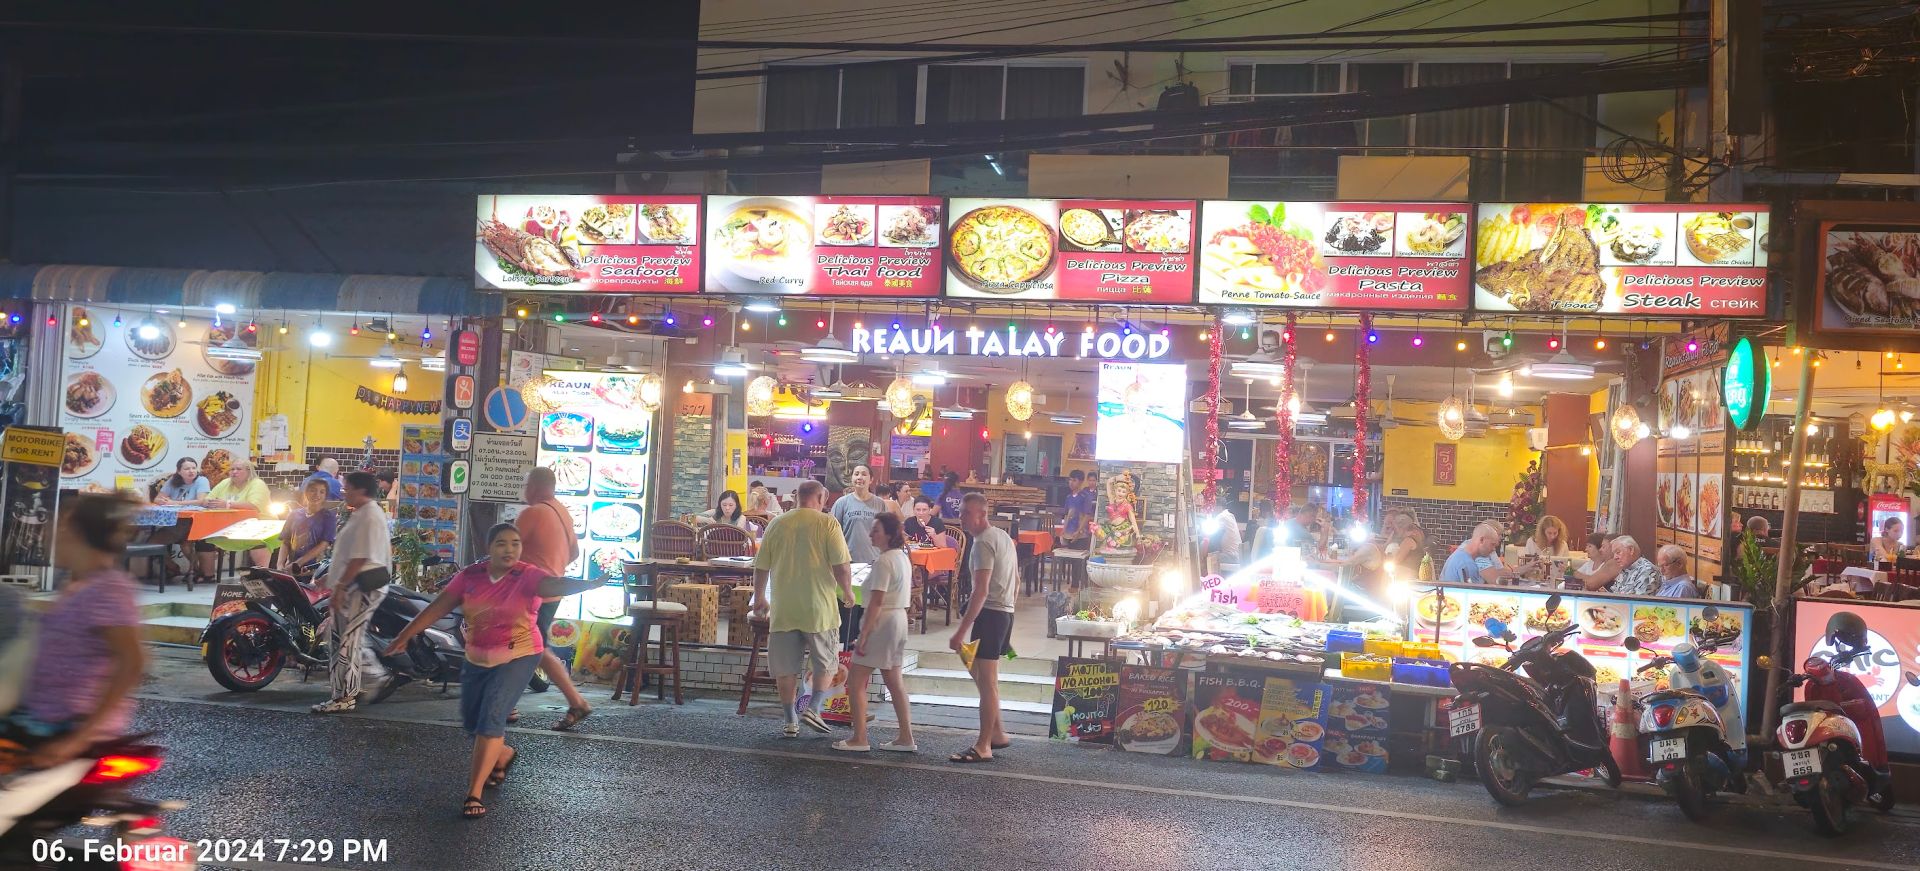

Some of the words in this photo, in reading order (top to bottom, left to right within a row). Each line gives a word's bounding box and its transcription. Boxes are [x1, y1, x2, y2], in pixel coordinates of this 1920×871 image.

[583, 255, 637, 266] Delicious
[642, 255, 691, 267] Preview
[817, 255, 874, 266] Delicious
[878, 255, 930, 267] Preview
[1066, 260, 1126, 270] Delicious
[1131, 261, 1186, 272] Preview
[601, 266, 679, 277] Seafood
[823, 266, 870, 277] Thai
[877, 266, 922, 278] food
[1328, 264, 1392, 276] Delicious
[1397, 266, 1458, 278] Preview
[759, 277, 776, 285] Red
[779, 277, 804, 286] Curry
[1101, 273, 1150, 284] Pizza
[1624, 274, 1692, 286] Delicious
[1699, 276, 1764, 287] Preview
[1097, 286, 1126, 294] пицца
[1358, 279, 1423, 292] Pasta
[1221, 290, 1250, 299] Penne
[1254, 291, 1290, 299] Tomato
[1293, 291, 1321, 300] Sauce
[1623, 293, 1701, 309] Steak
[1710, 296, 1759, 309] стейк
[1843, 315, 1871, 323] Mixed
[1874, 316, 1911, 324] Seafood
[966, 330, 1065, 357] TALAY
[1080, 331, 1170, 359] FOOD
[682, 404, 705, 416] 577
[8, 434, 63, 447] MOTORBIKE
[10, 446, 29, 455] FOR
[30, 448, 55, 457] RENT
[1876, 501, 1902, 511] Coca-Cola
[1202, 577, 1221, 590] RED
[1210, 589, 1238, 605] Fish
[1070, 664, 1106, 676] MOJITO
[1077, 676, 1117, 687] ALCOHOL
[1157, 675, 1176, 683] RICE
[1199, 676, 1223, 686] FISH
[1072, 711, 1104, 721] MOJITO
[1456, 722, 1476, 734] 4788
[1792, 765, 1813, 776] 659
